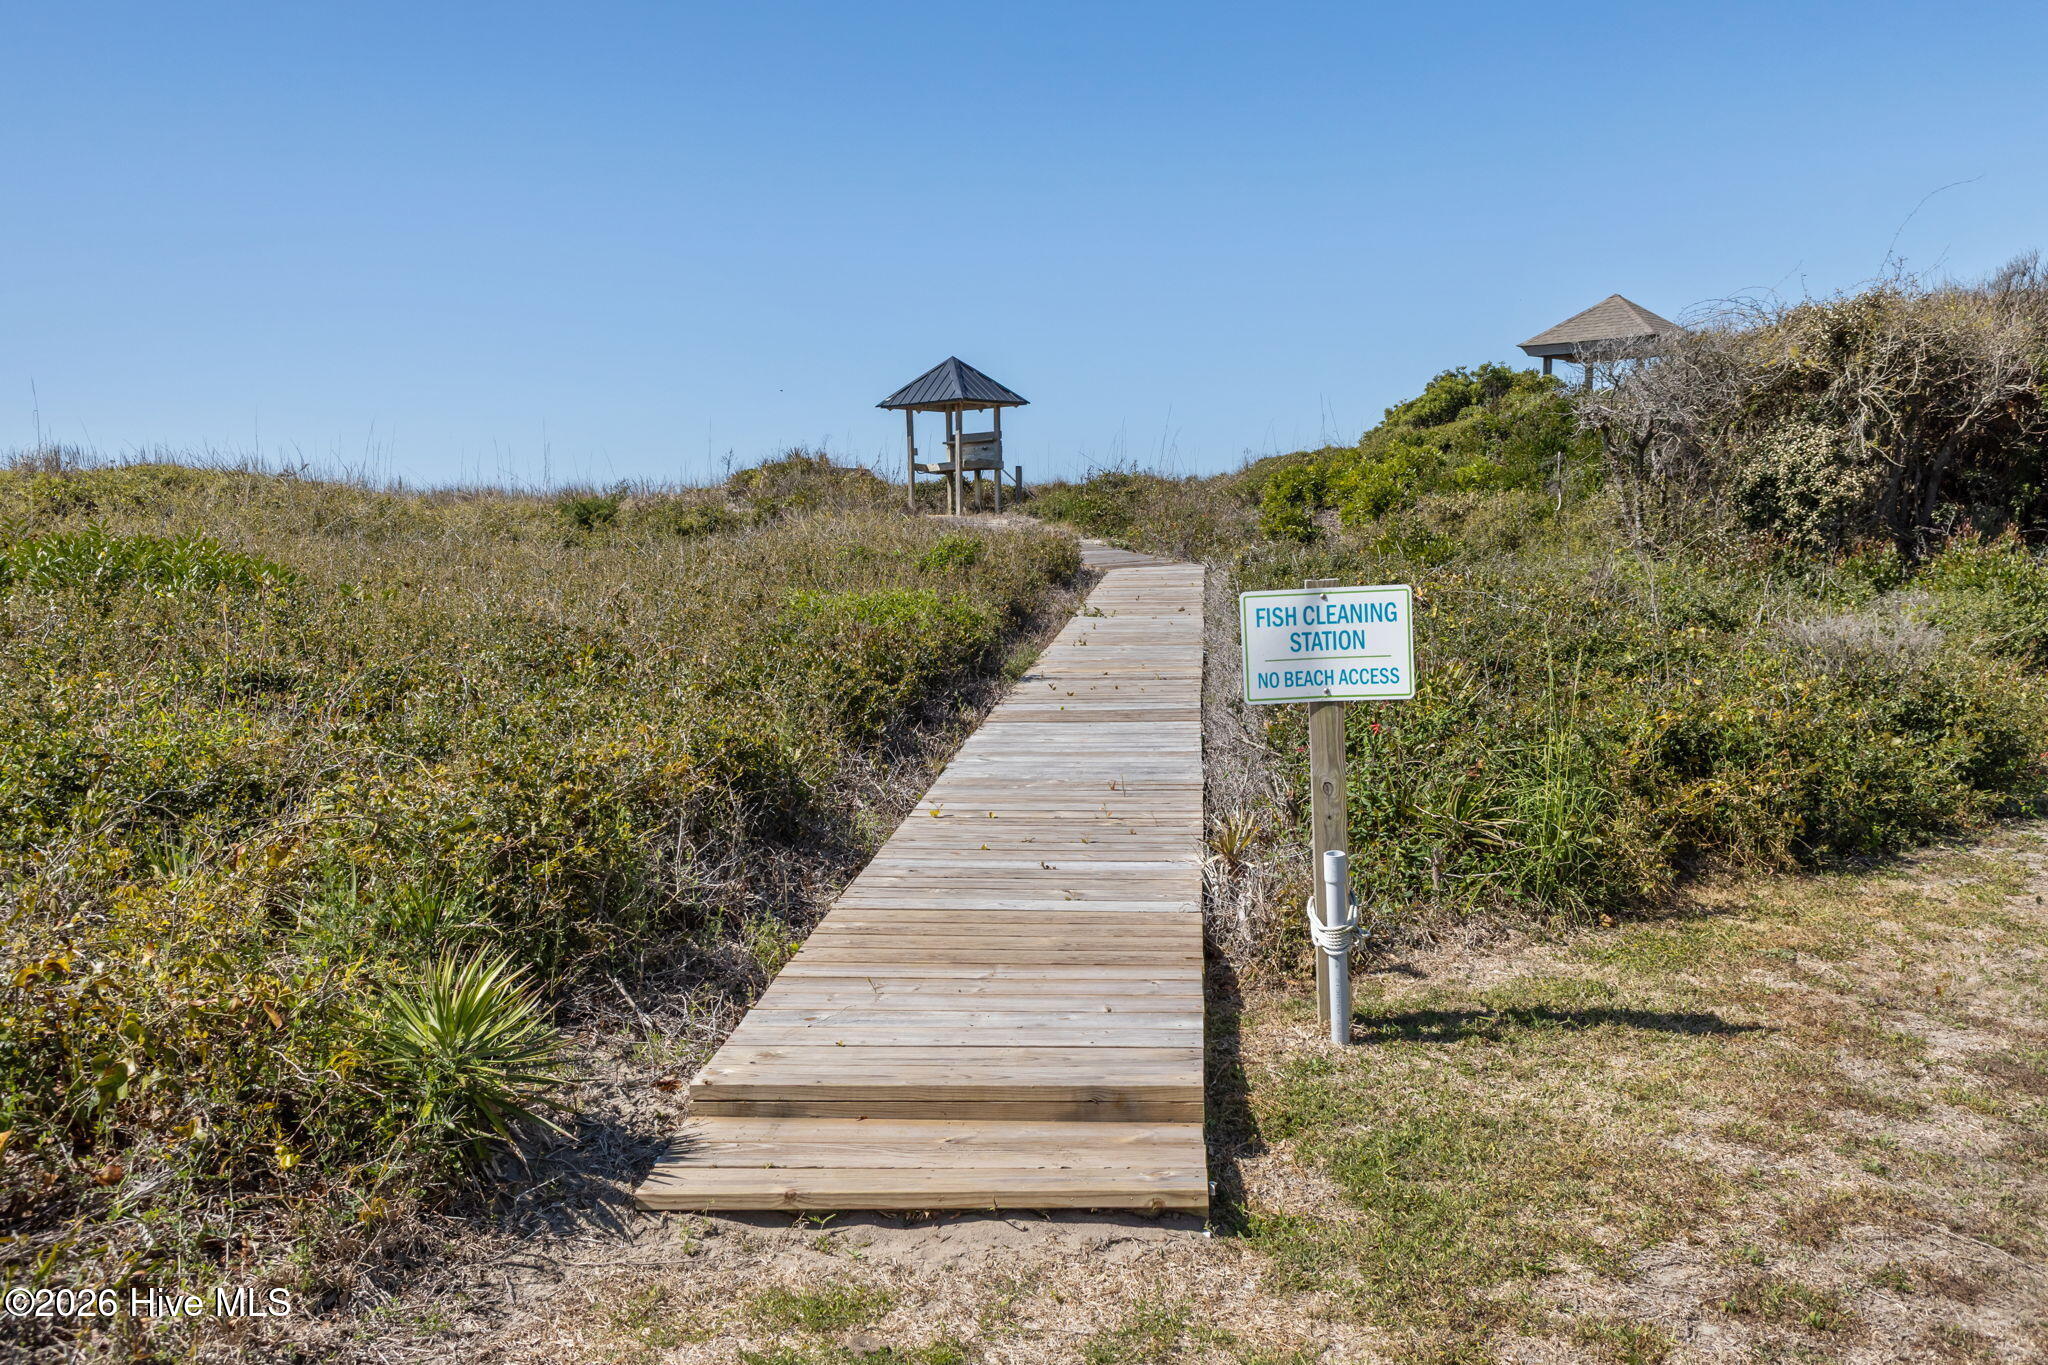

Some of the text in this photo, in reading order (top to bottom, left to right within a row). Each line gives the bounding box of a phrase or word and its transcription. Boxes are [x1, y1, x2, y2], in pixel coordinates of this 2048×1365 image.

[1255, 602, 1398, 628] FISH CLEANING
[1290, 629, 1366, 653] STATION
[1258, 667, 1400, 689] NO BEACH ACCESS
